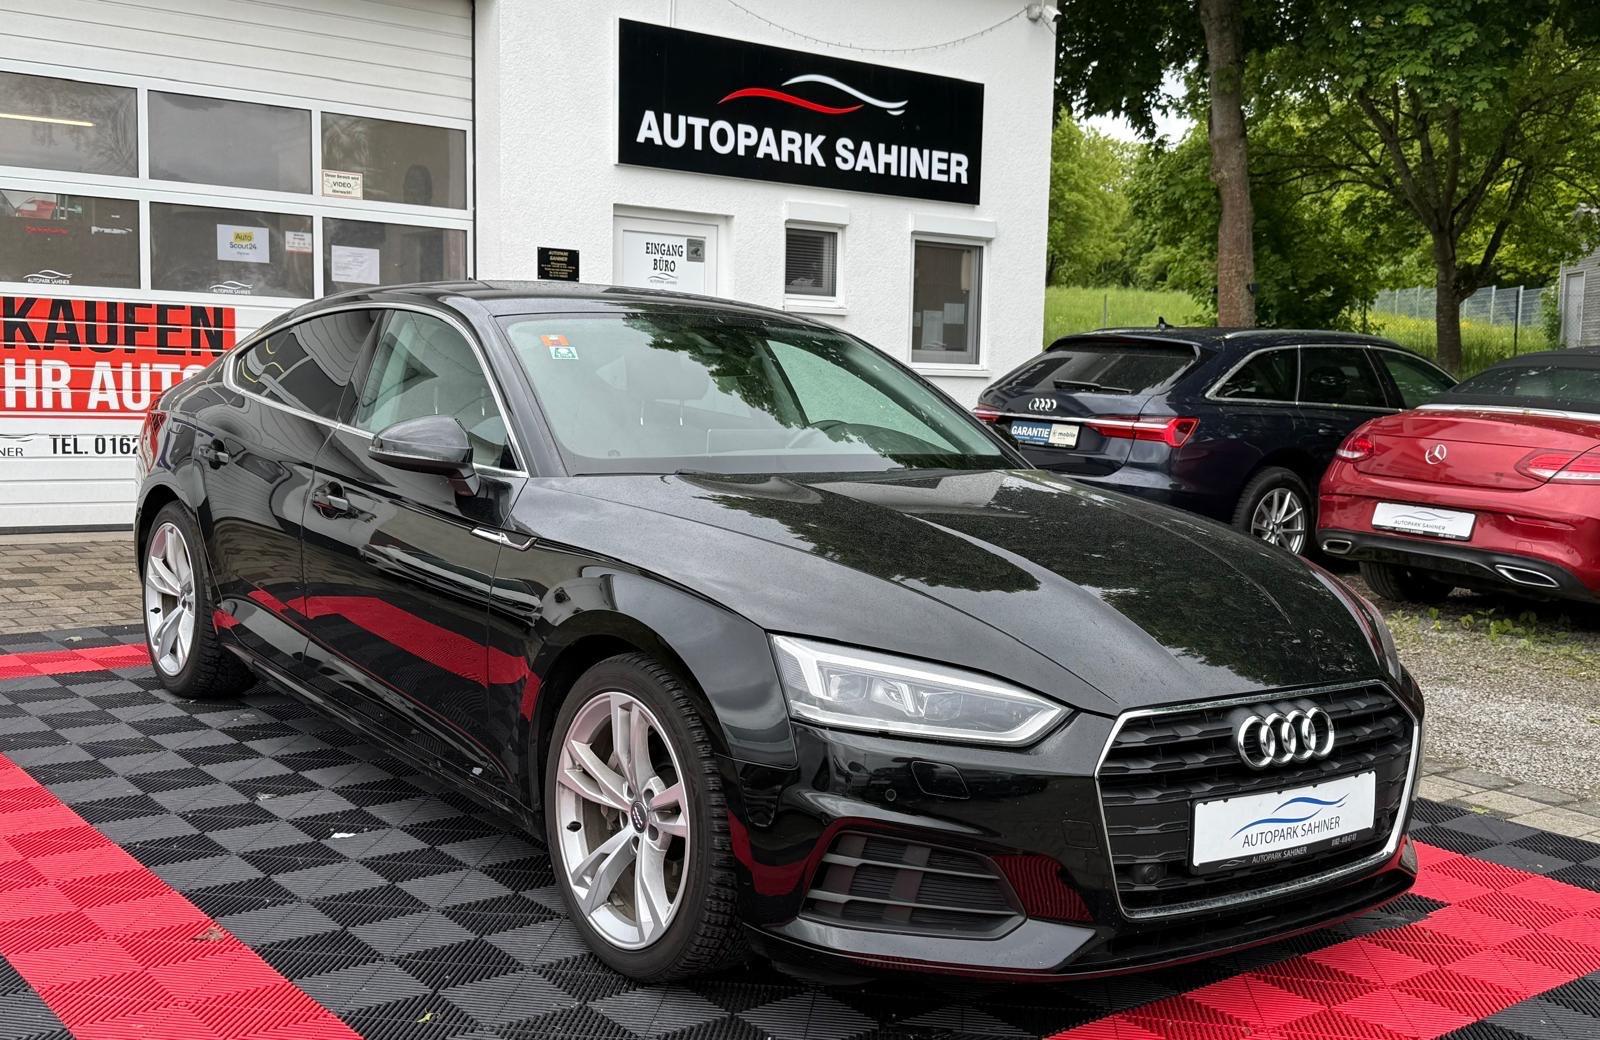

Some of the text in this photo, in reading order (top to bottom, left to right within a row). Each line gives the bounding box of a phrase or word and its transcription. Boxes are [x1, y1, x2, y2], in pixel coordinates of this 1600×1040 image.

[636, 109, 970, 186] AUTOPARK SAHINER
[332, 181, 352, 189] VIDEO
[235, 232, 252, 241] Auto
[229, 241, 257, 250] Scout24
[645, 241, 684, 258] EINGANG
[652, 256, 677, 273] BÜRO
[3, 296, 224, 358] KAUFEN
[87, 360, 206, 411] AUT
[1011, 426, 1050, 438] GARANTIE
[49, 434, 89, 455] TEL.
[1394, 519, 1421, 529] AUTOPARK
[1422, 523, 1446, 531] SAHINER
[1242, 816, 1340, 848] AUTOPARK SAHINER
[1252, 846, 1308, 864] AUTOPARK SAHINER
